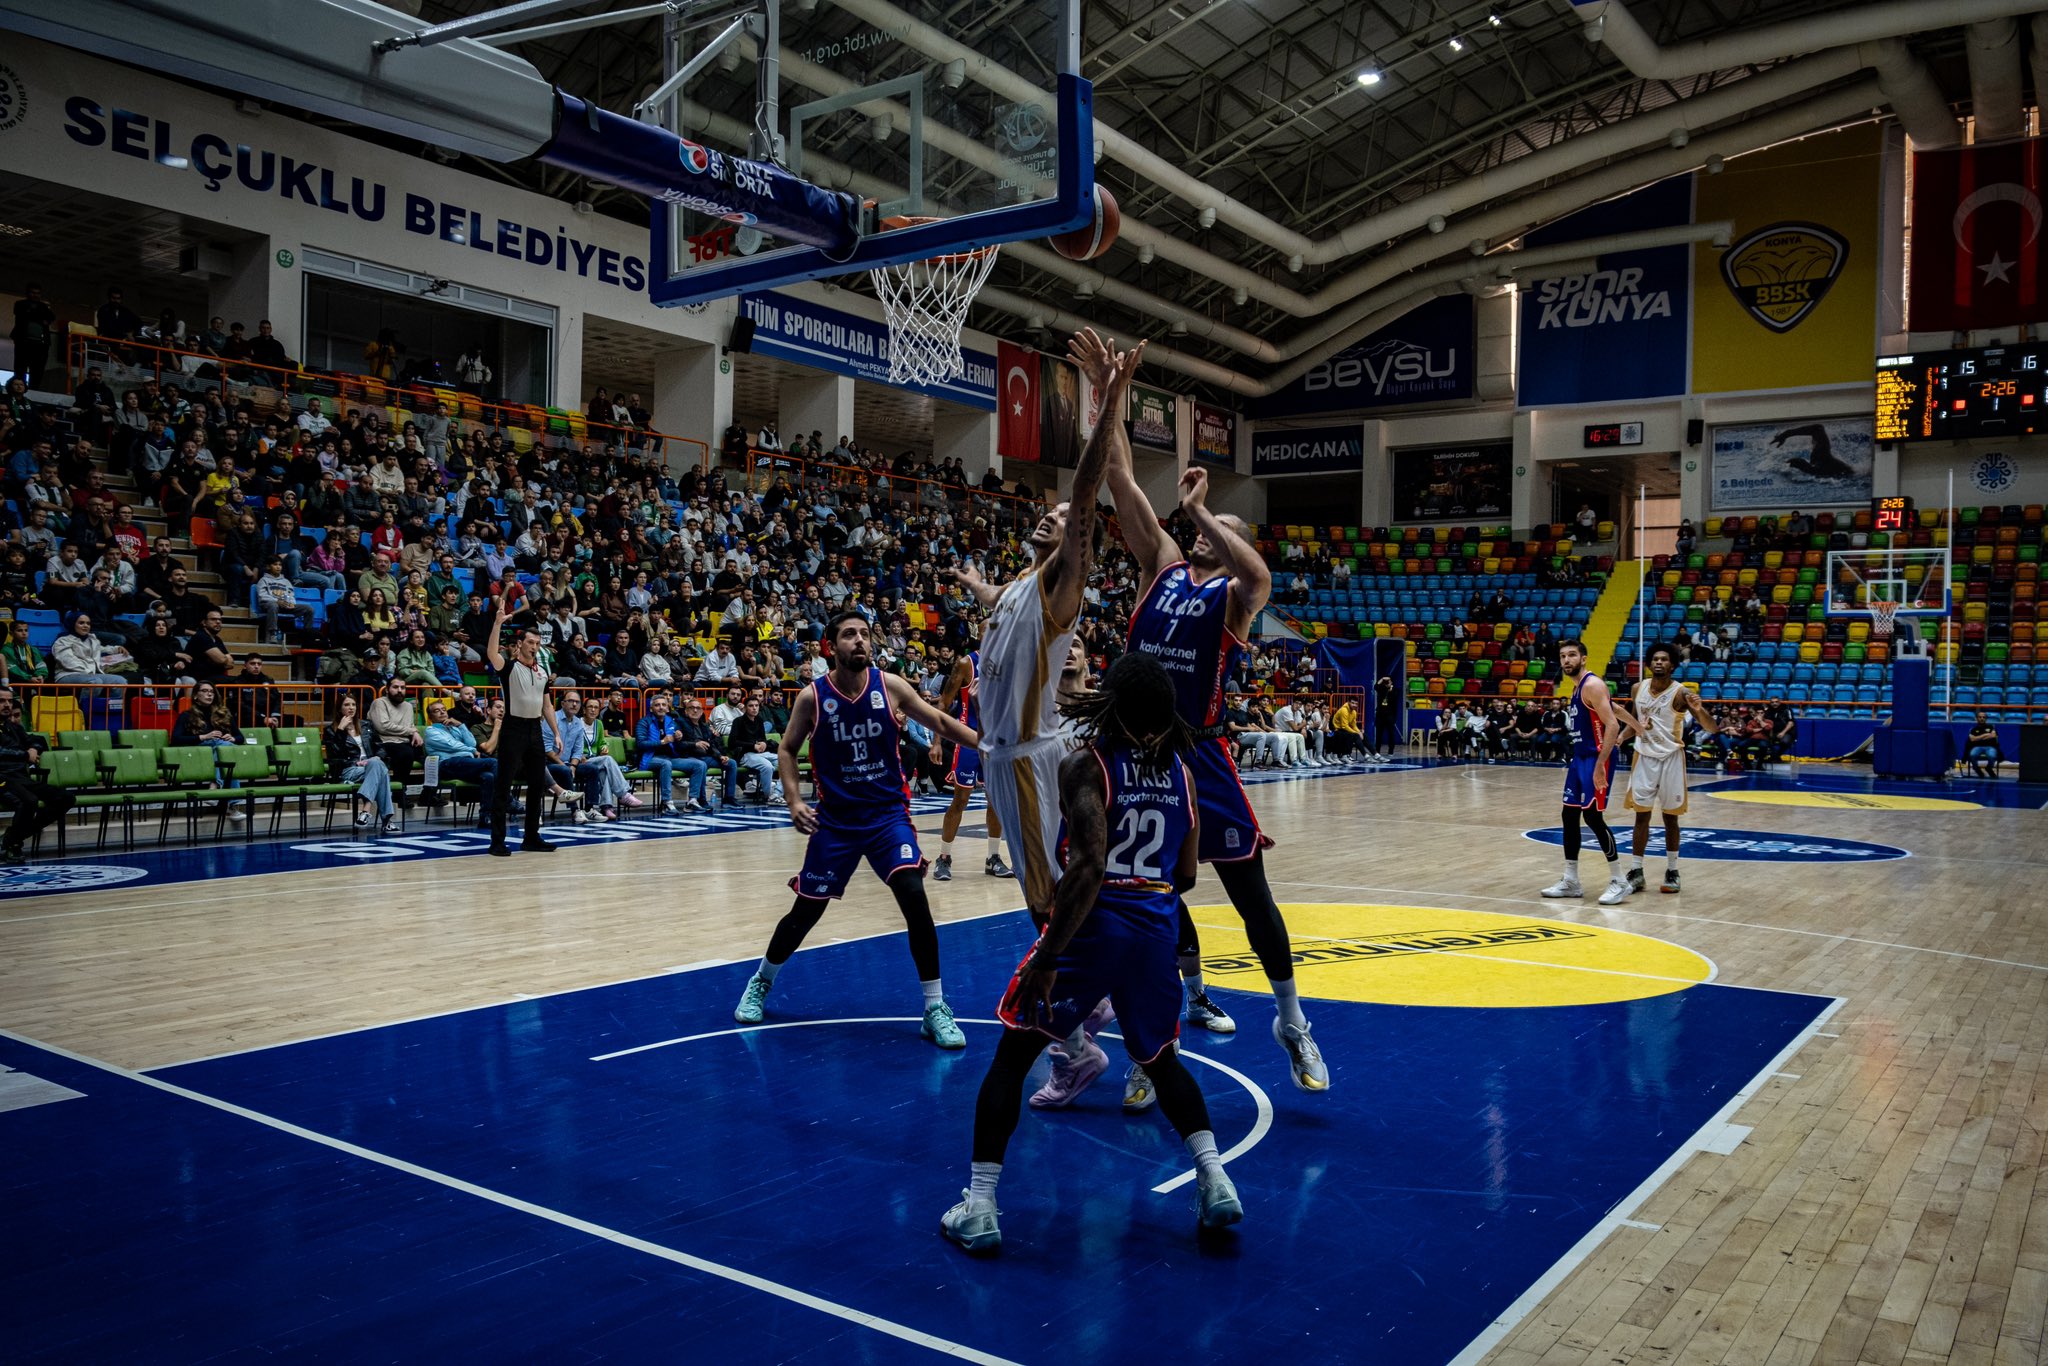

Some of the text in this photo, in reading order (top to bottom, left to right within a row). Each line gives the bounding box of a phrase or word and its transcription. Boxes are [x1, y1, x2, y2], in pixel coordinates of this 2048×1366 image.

[64, 96, 650, 292] SELÇUKLU BELEDİYES
[1765, 236, 1802, 247] KONYA
[279, 250, 292, 262] C2
[1537, 267, 1645, 303] SPOR
[1756, 281, 1811, 303] BBSK
[1538, 289, 1673, 330] KONYA
[745, 298, 779, 333] TÜM
[784, 311, 875, 357] SPORCULARA
[849, 358, 869, 371] Ahmet
[1960, 360, 1975, 375] 15
[2022, 354, 2037, 370] 16
[1980, 380, 2017, 398] 2:26
[1256, 440, 1350, 461] MEDICANA
[1880, 498, 1905, 509] 2:26
[1876, 511, 1902, 529] 24
[1155, 589, 1206, 617] iLab
[1164, 618, 1179, 642] 7
[1139, 639, 1197, 660] kariyer.net
[832, 718, 882, 742] iLab
[851, 740, 868, 762] 13
[840, 758, 885, 773] kariyer.net
[1122, 762, 1173, 789] LYKES
[1105, 808, 1166, 879] 22
